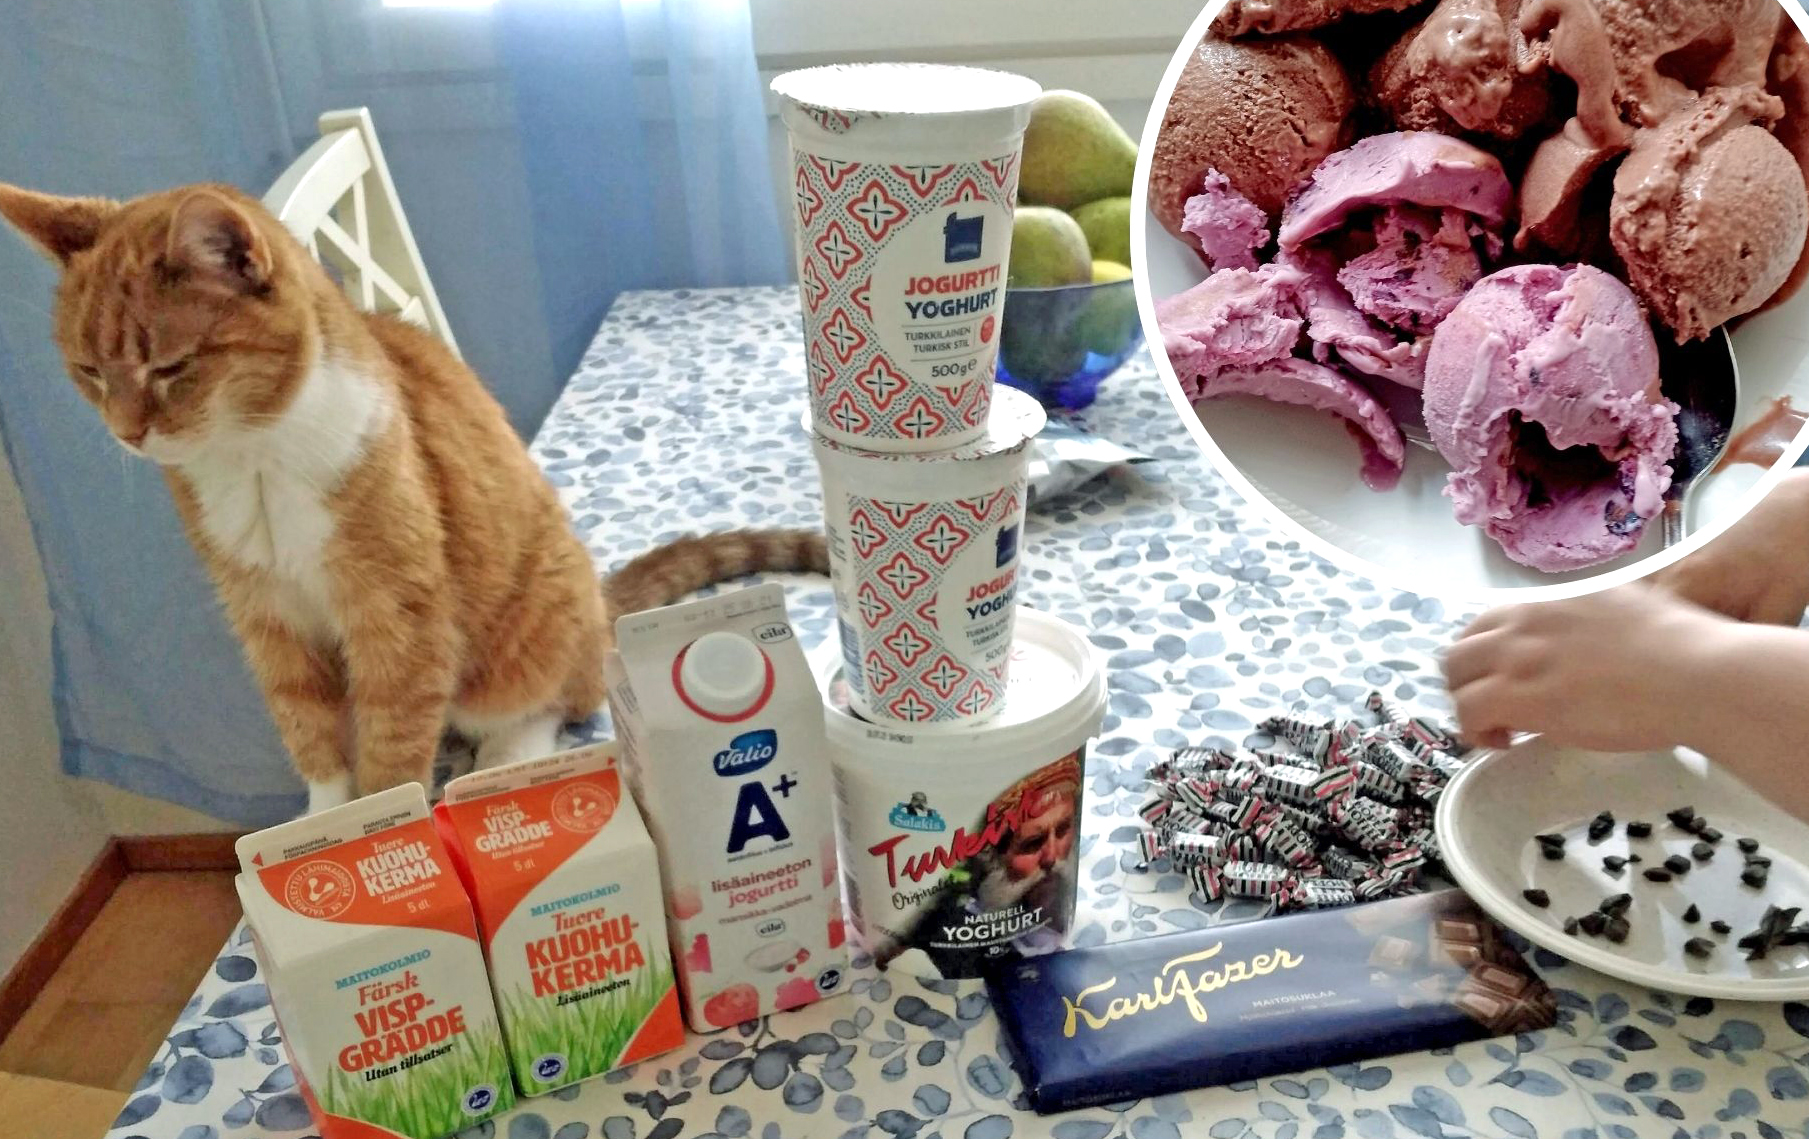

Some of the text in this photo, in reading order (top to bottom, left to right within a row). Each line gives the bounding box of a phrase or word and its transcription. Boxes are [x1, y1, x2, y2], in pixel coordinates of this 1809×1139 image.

[905, 264, 1001, 296] JOGURTTI
[904, 287, 998, 319] YOGHURT
[905, 326, 971, 341] TURKKILAINEN
[913, 339, 970, 353] TURKISK STIL
[718, 743, 773, 769] Valio
[483, 811, 531, 833] VISP-
[727, 773, 797, 854] A+
[894, 814, 941, 830] Salakis
[356, 841, 430, 879] KUOHU-
[371, 838, 405, 853] Tuore
[364, 858, 442, 896] KERMA
[513, 859, 522, 872] 5
[711, 859, 812, 892] lisäaineeton
[407, 899, 431, 913] 5 dl
[530, 883, 621, 917] MAITOKOLMIO
[728, 874, 799, 909] jogurtti
[551, 907, 606, 932] Tuore
[943, 907, 1043, 941] YOGHURT
[965, 905, 1026, 925] NATURELL
[525, 913, 640, 970] KUOHU-
[335, 949, 431, 989] MAITOKOLMIO
[531, 941, 646, 998] KERMA
[1163, 941, 1304, 1023] Fazer
[358, 970, 420, 1006] Färsk
[1252, 989, 1337, 1008] MAITOSUKLAA
[354, 992, 435, 1038] VISP-
[338, 1005, 467, 1072] GRÄDDE
[365, 1044, 453, 1081] Utan tillsatser
